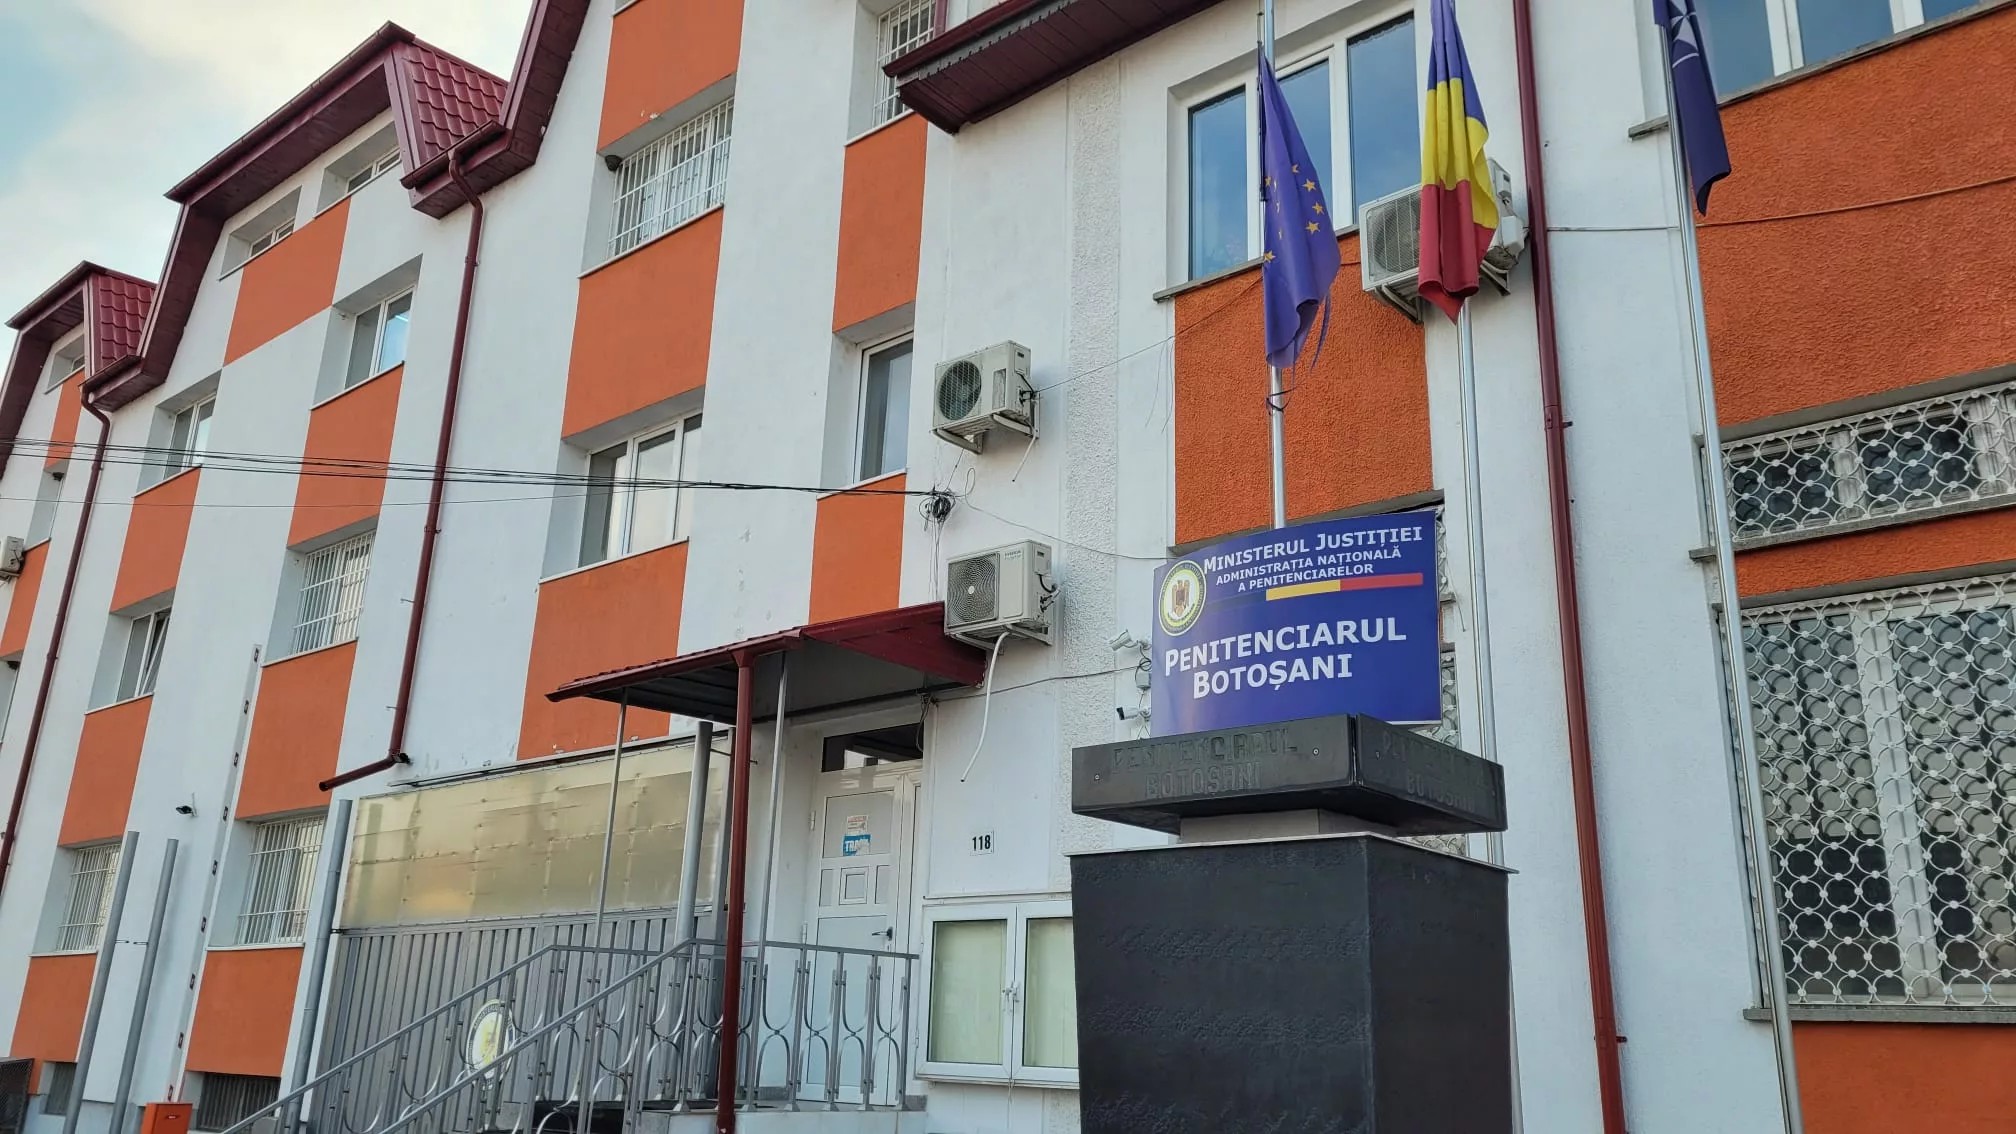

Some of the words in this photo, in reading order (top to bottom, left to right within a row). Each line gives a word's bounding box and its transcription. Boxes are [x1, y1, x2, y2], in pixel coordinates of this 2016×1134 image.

[1204, 539, 1309, 575] MINISTERUL
[1315, 526, 1422, 551] JUSTIȚIEI
[1317, 545, 1402, 566] NAȚIONALĂ
[1238, 582, 1246, 593] A
[1249, 564, 1374, 590] PENITENCIARELOR
[1165, 617, 1407, 676] PENITENCIARUL
[1193, 653, 1352, 700] BOTOȘANI
[972, 834, 991, 851] 118
